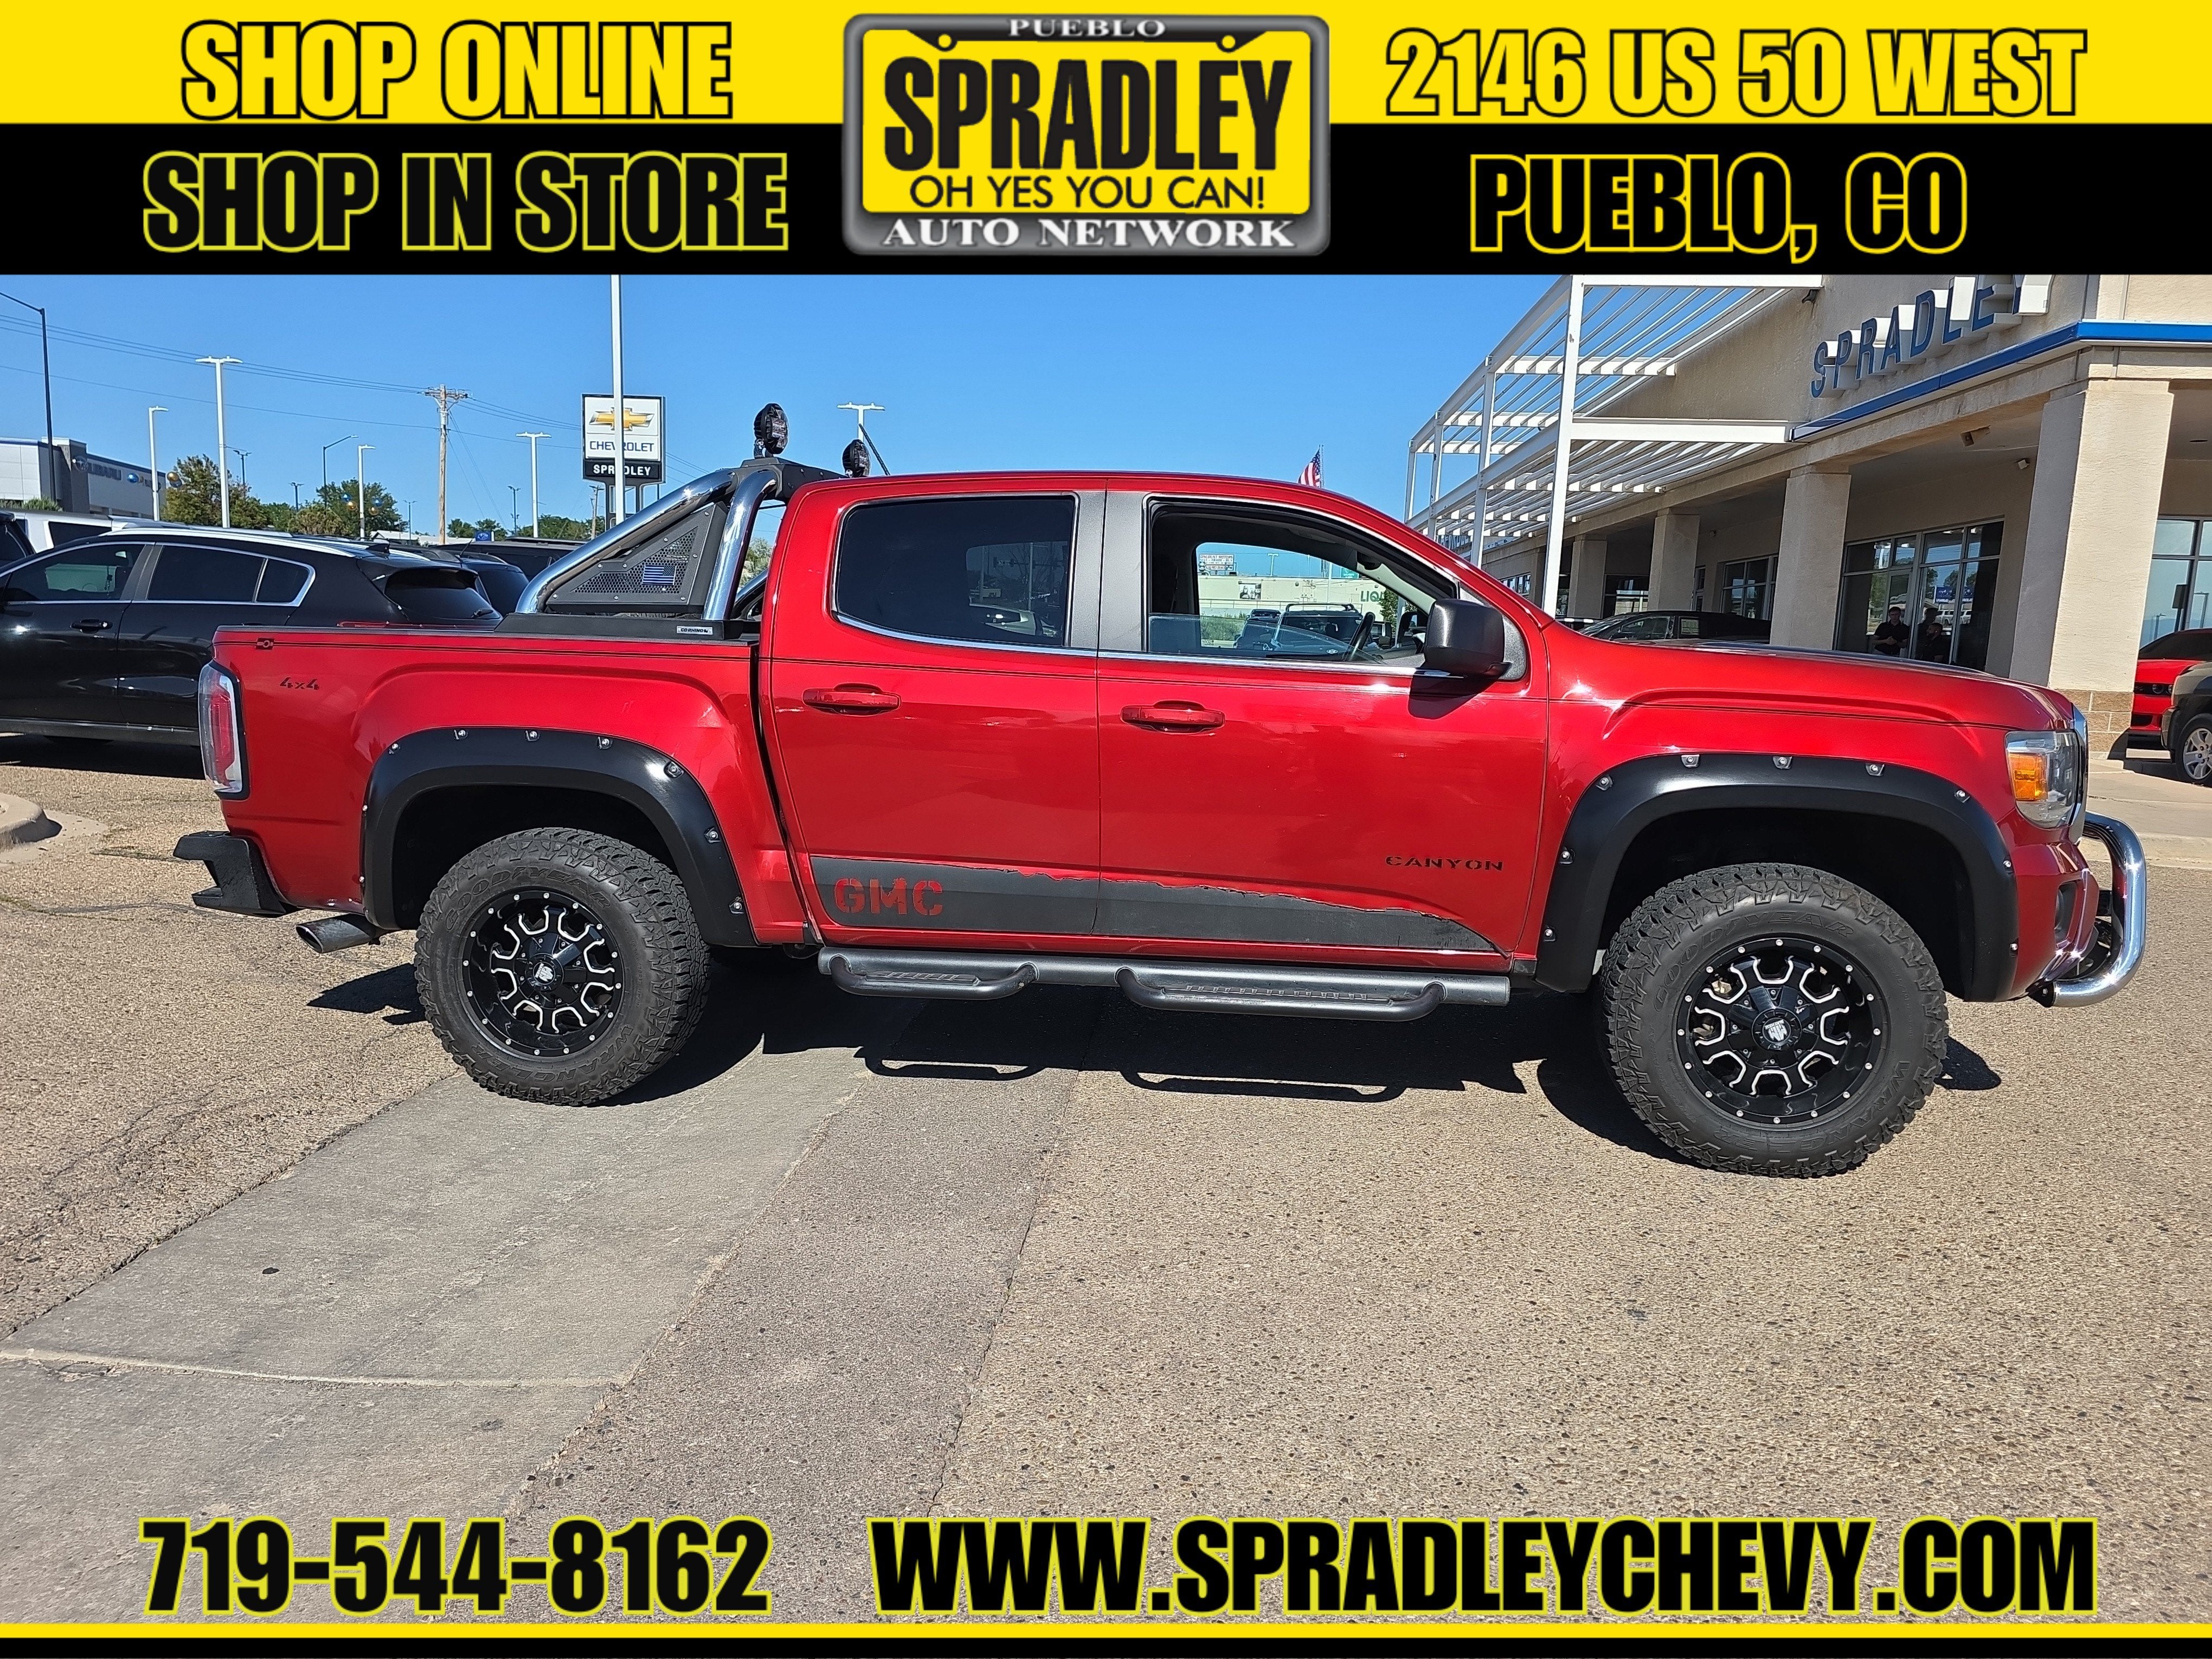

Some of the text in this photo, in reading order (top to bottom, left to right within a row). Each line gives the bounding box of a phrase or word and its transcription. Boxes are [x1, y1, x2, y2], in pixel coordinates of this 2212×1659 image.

[593, 464, 651, 476] SPRDLEY
[280, 677, 320, 691] 4x4
[1385, 856, 1503, 871] CANYON
[445, 866, 611, 931] GOODYEAR
[834, 878, 943, 916] GMC
[1654, 911, 1855, 1012] GOODYEAR
[472, 1025, 634, 1082] WRANGLER
[1713, 1061, 1910, 1153] WRANGLER
